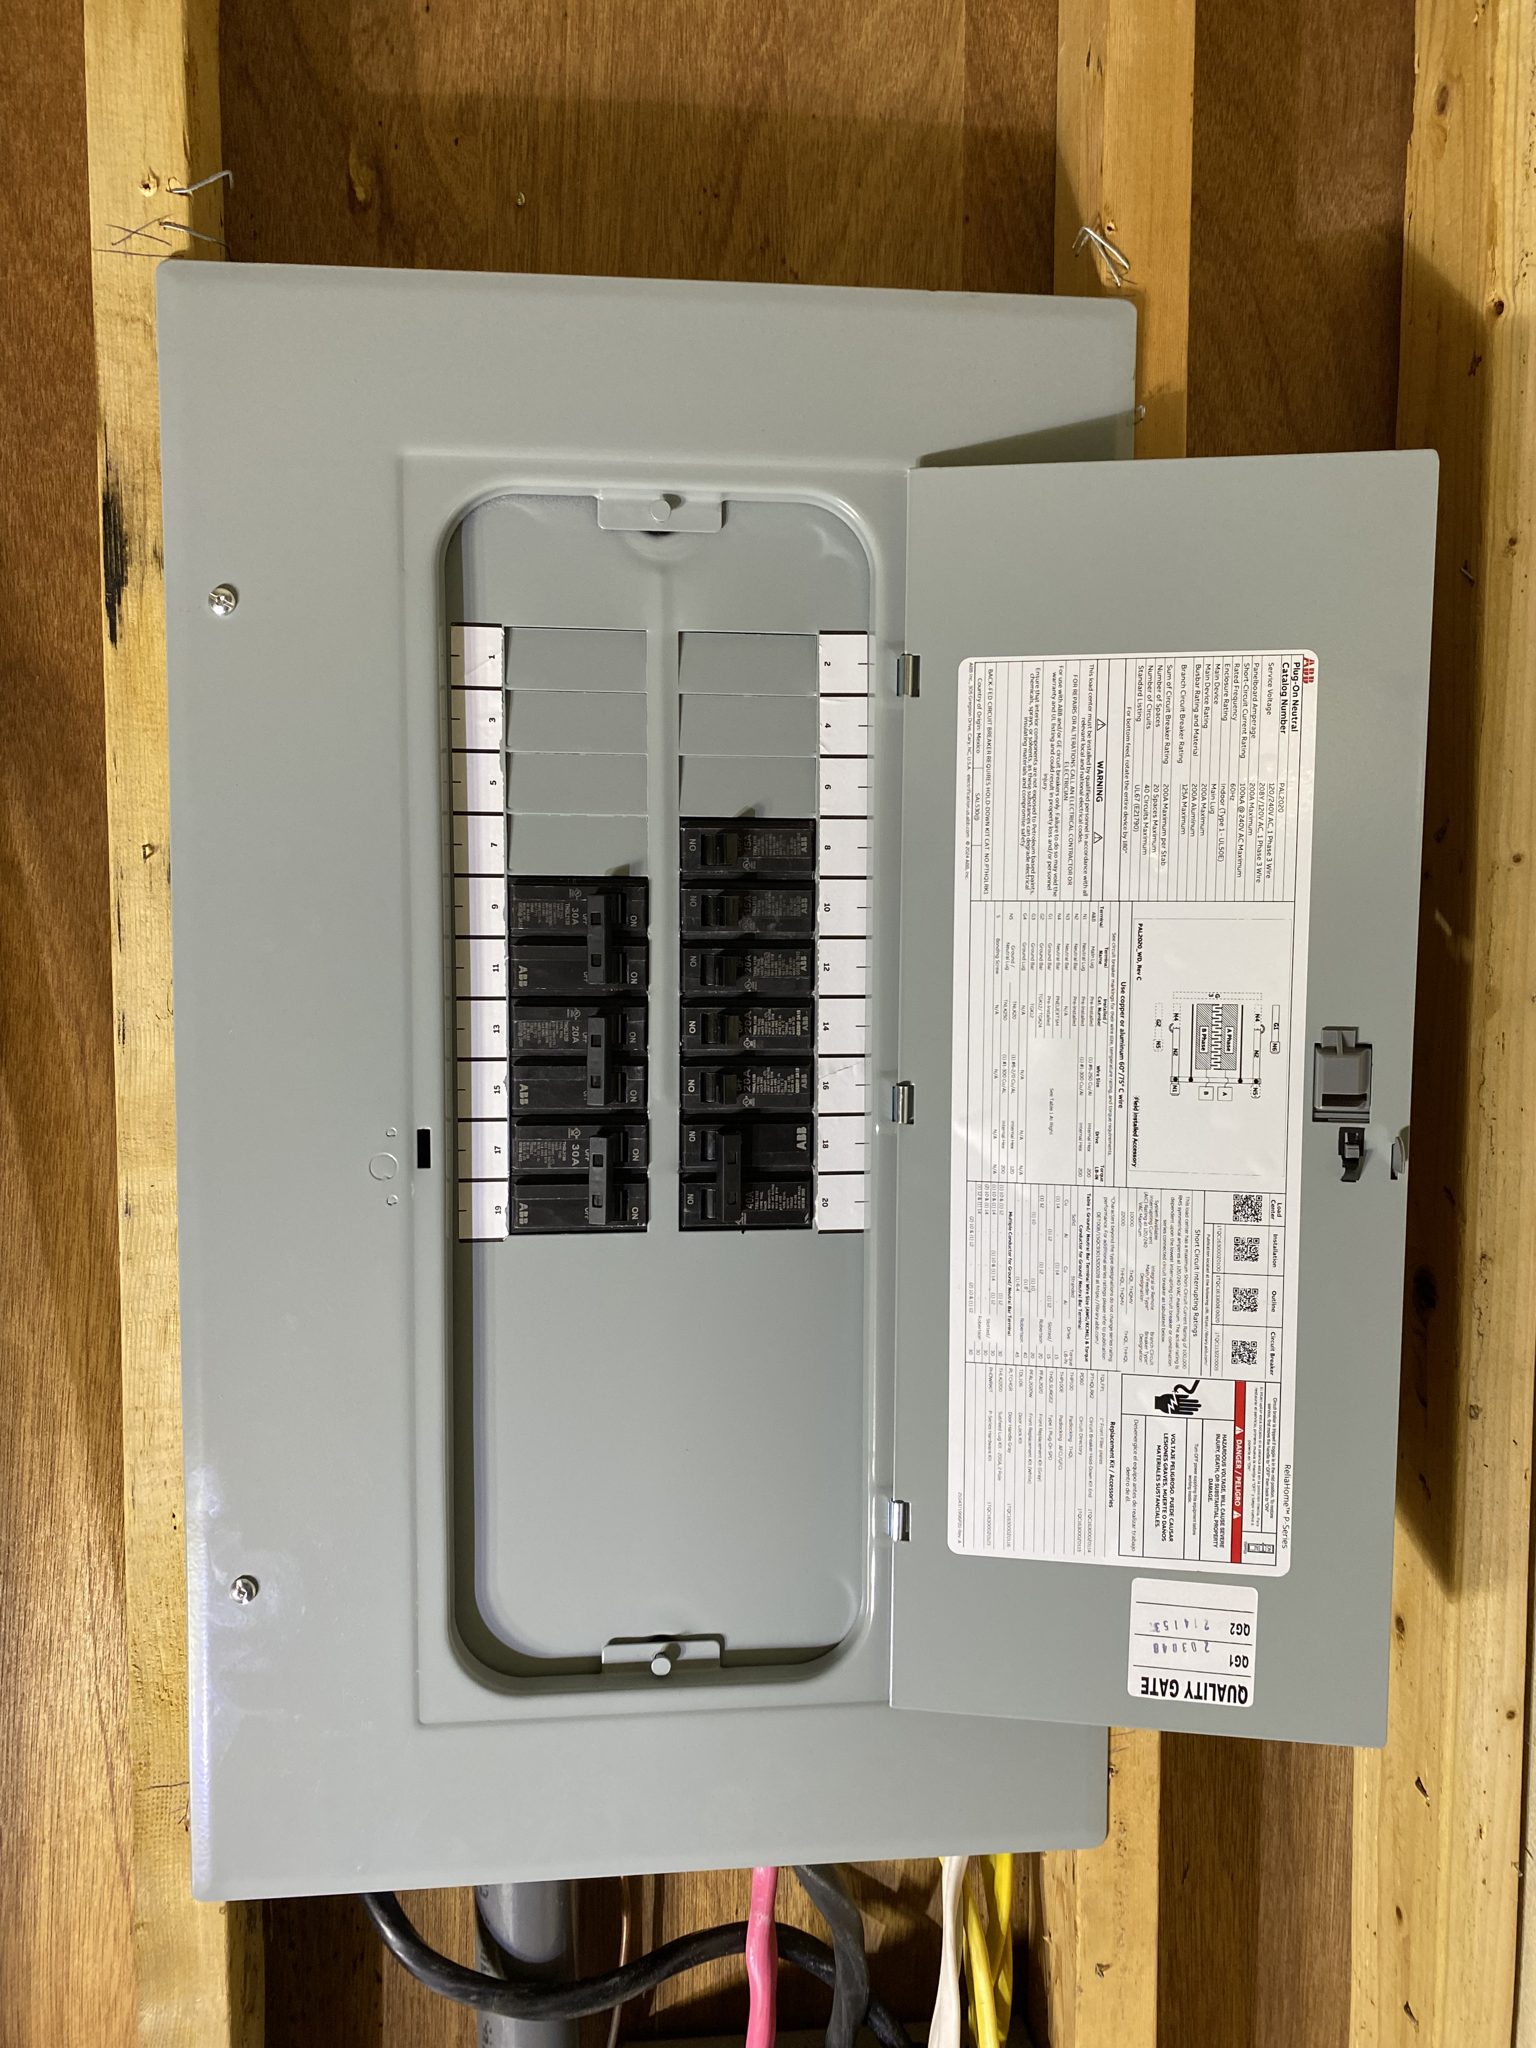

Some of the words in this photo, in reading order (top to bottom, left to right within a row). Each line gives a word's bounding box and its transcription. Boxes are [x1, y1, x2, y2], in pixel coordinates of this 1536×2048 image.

[1154, 664, 1163, 693] Number
[1222, 663, 1230, 697] Enclosure
[1279, 661, 1289, 697] Catalog
[1290, 662, 1300, 697] Plug-On
[1302, 656, 1314, 684] ABB
[1241, 662, 1249, 707] Short-Circuit
[1251, 662, 1259, 701] Panelboard
[1155, 693, 1162, 701] of
[1230, 685, 1239, 721] Frequency
[1264, 688, 1273, 715] Voltage
[1134, 698, 1143, 722] Listing
[1153, 703, 1162, 727] Spaces
[1220, 698, 1229, 721] Rating
[1279, 699, 1288, 734] Number
[1290, 699, 1299, 731] Neutral
[1249, 703, 1258, 739] Amperage
[1238, 736, 1247, 758] Rating
[1095, 760, 1104, 802] WARNING
[1152, 783, 1159, 792] 20
[1150, 793, 1159, 818] Spaces
[1218, 783, 1226, 806] Indoor
[1266, 783, 1274, 816] 120/240V
[1277, 782, 1285, 813] PAL2020
[1217, 807, 1225, 826] (Type
[689, 839, 697, 851] ON
[1237, 832, 1244, 843] AC
[824, 902, 831, 912] 10
[630, 915, 638, 927] ON
[493, 964, 500, 972] 11
[519, 965, 528, 987] ABB
[631, 972, 638, 984] ON
[823, 962, 830, 972] 12
[1117, 995, 1125, 1018] copper
[493, 1024, 500, 1034] 13
[689, 1021, 696, 1033] ON
[744, 1011, 752, 1034] 20A
[823, 1022, 829, 1031] 14
[1119, 1019, 1124, 1027] or
[629, 1031, 636, 1043] ON
[494, 1085, 501, 1094] 15
[688, 1079, 695, 1092] ON
[743, 1069, 751, 1092] 20A
[823, 1081, 829, 1090] 16
[519, 1084, 528, 1105] ABB
[796, 1127, 807, 1150] ABB
[822, 1139, 829, 1149] 18
[494, 1146, 501, 1154] 17
[572, 1144, 580, 1166] 30A
[632, 1148, 639, 1161] ON
[495, 1205, 502, 1215] 19
[822, 1197, 828, 1207] 20
[519, 1203, 528, 1225] ABB
[631, 1207, 638, 1220] ON
[1191, 1271, 1199, 1311] Interrupting
[1191, 1312, 1199, 1337] Ratings
[1234, 1439, 1242, 1469] DANGER
[1214, 1473, 1219, 1482] OR
[1233, 1475, 1241, 1506] PELIGRO
[1281, 1516, 1289, 1549] P-Series
[1230, 1622, 1250, 1636] QG2
[1229, 1655, 1249, 1668] QG1
[1141, 1677, 1179, 1698] GATE
[1184, 1681, 1248, 1704] QUALITY
